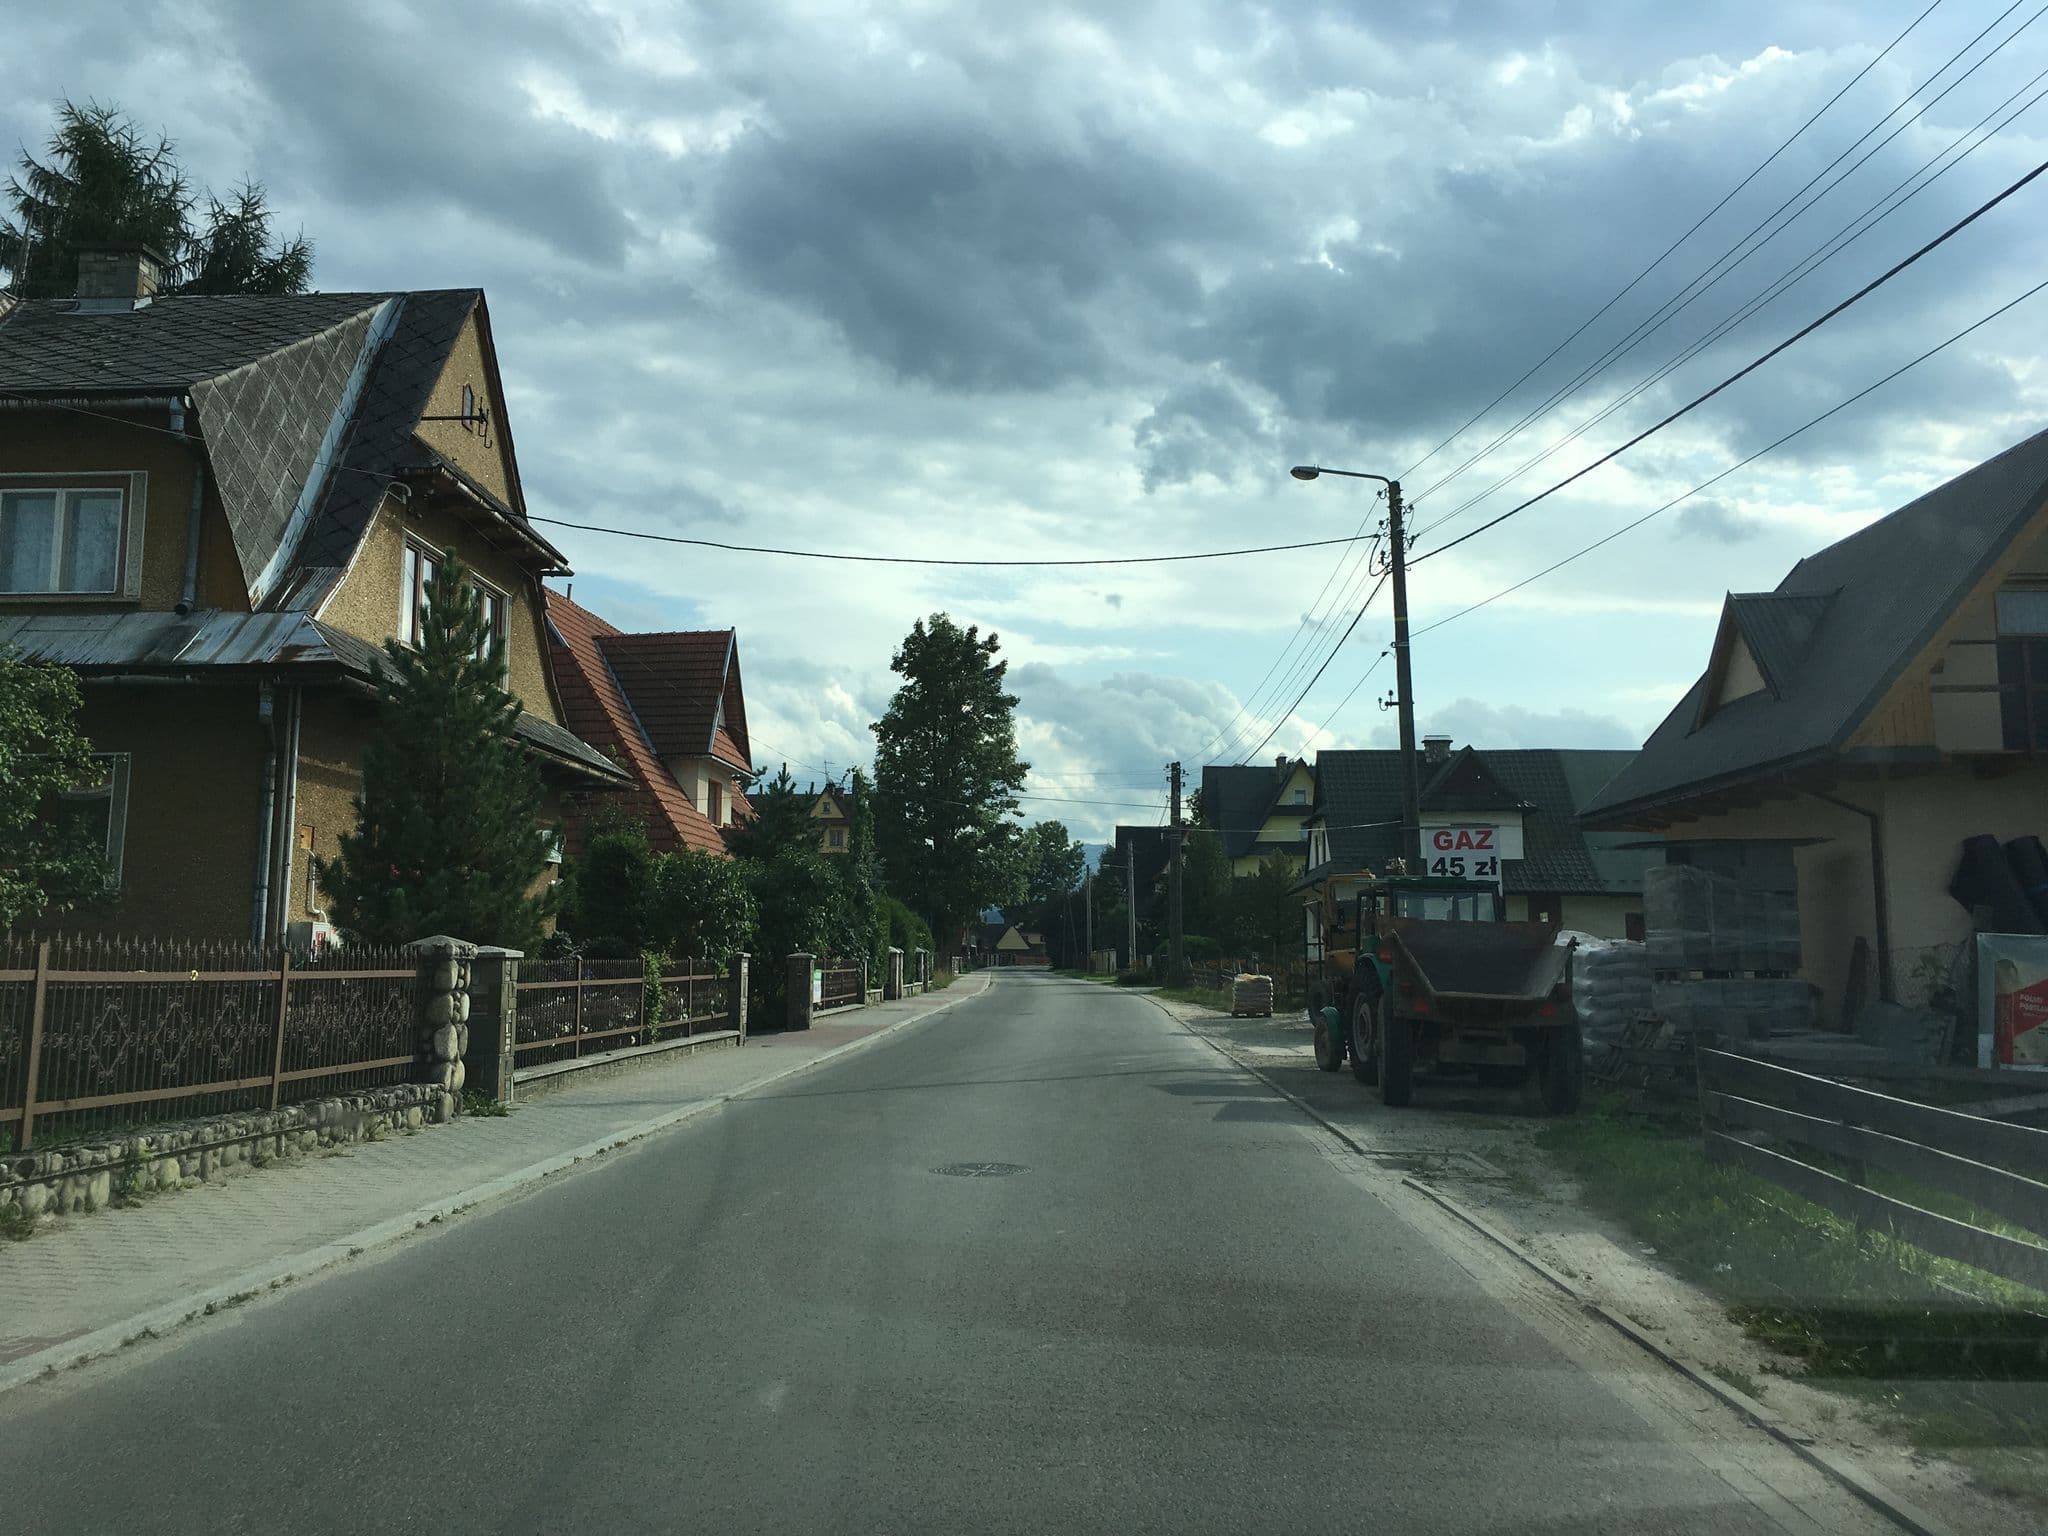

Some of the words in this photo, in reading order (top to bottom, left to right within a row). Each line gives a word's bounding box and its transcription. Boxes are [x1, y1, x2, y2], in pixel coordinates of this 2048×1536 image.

[1433, 830, 1494, 851] GAZ
[1431, 856, 1466, 876] 45
[1474, 856, 1498, 876] zł
